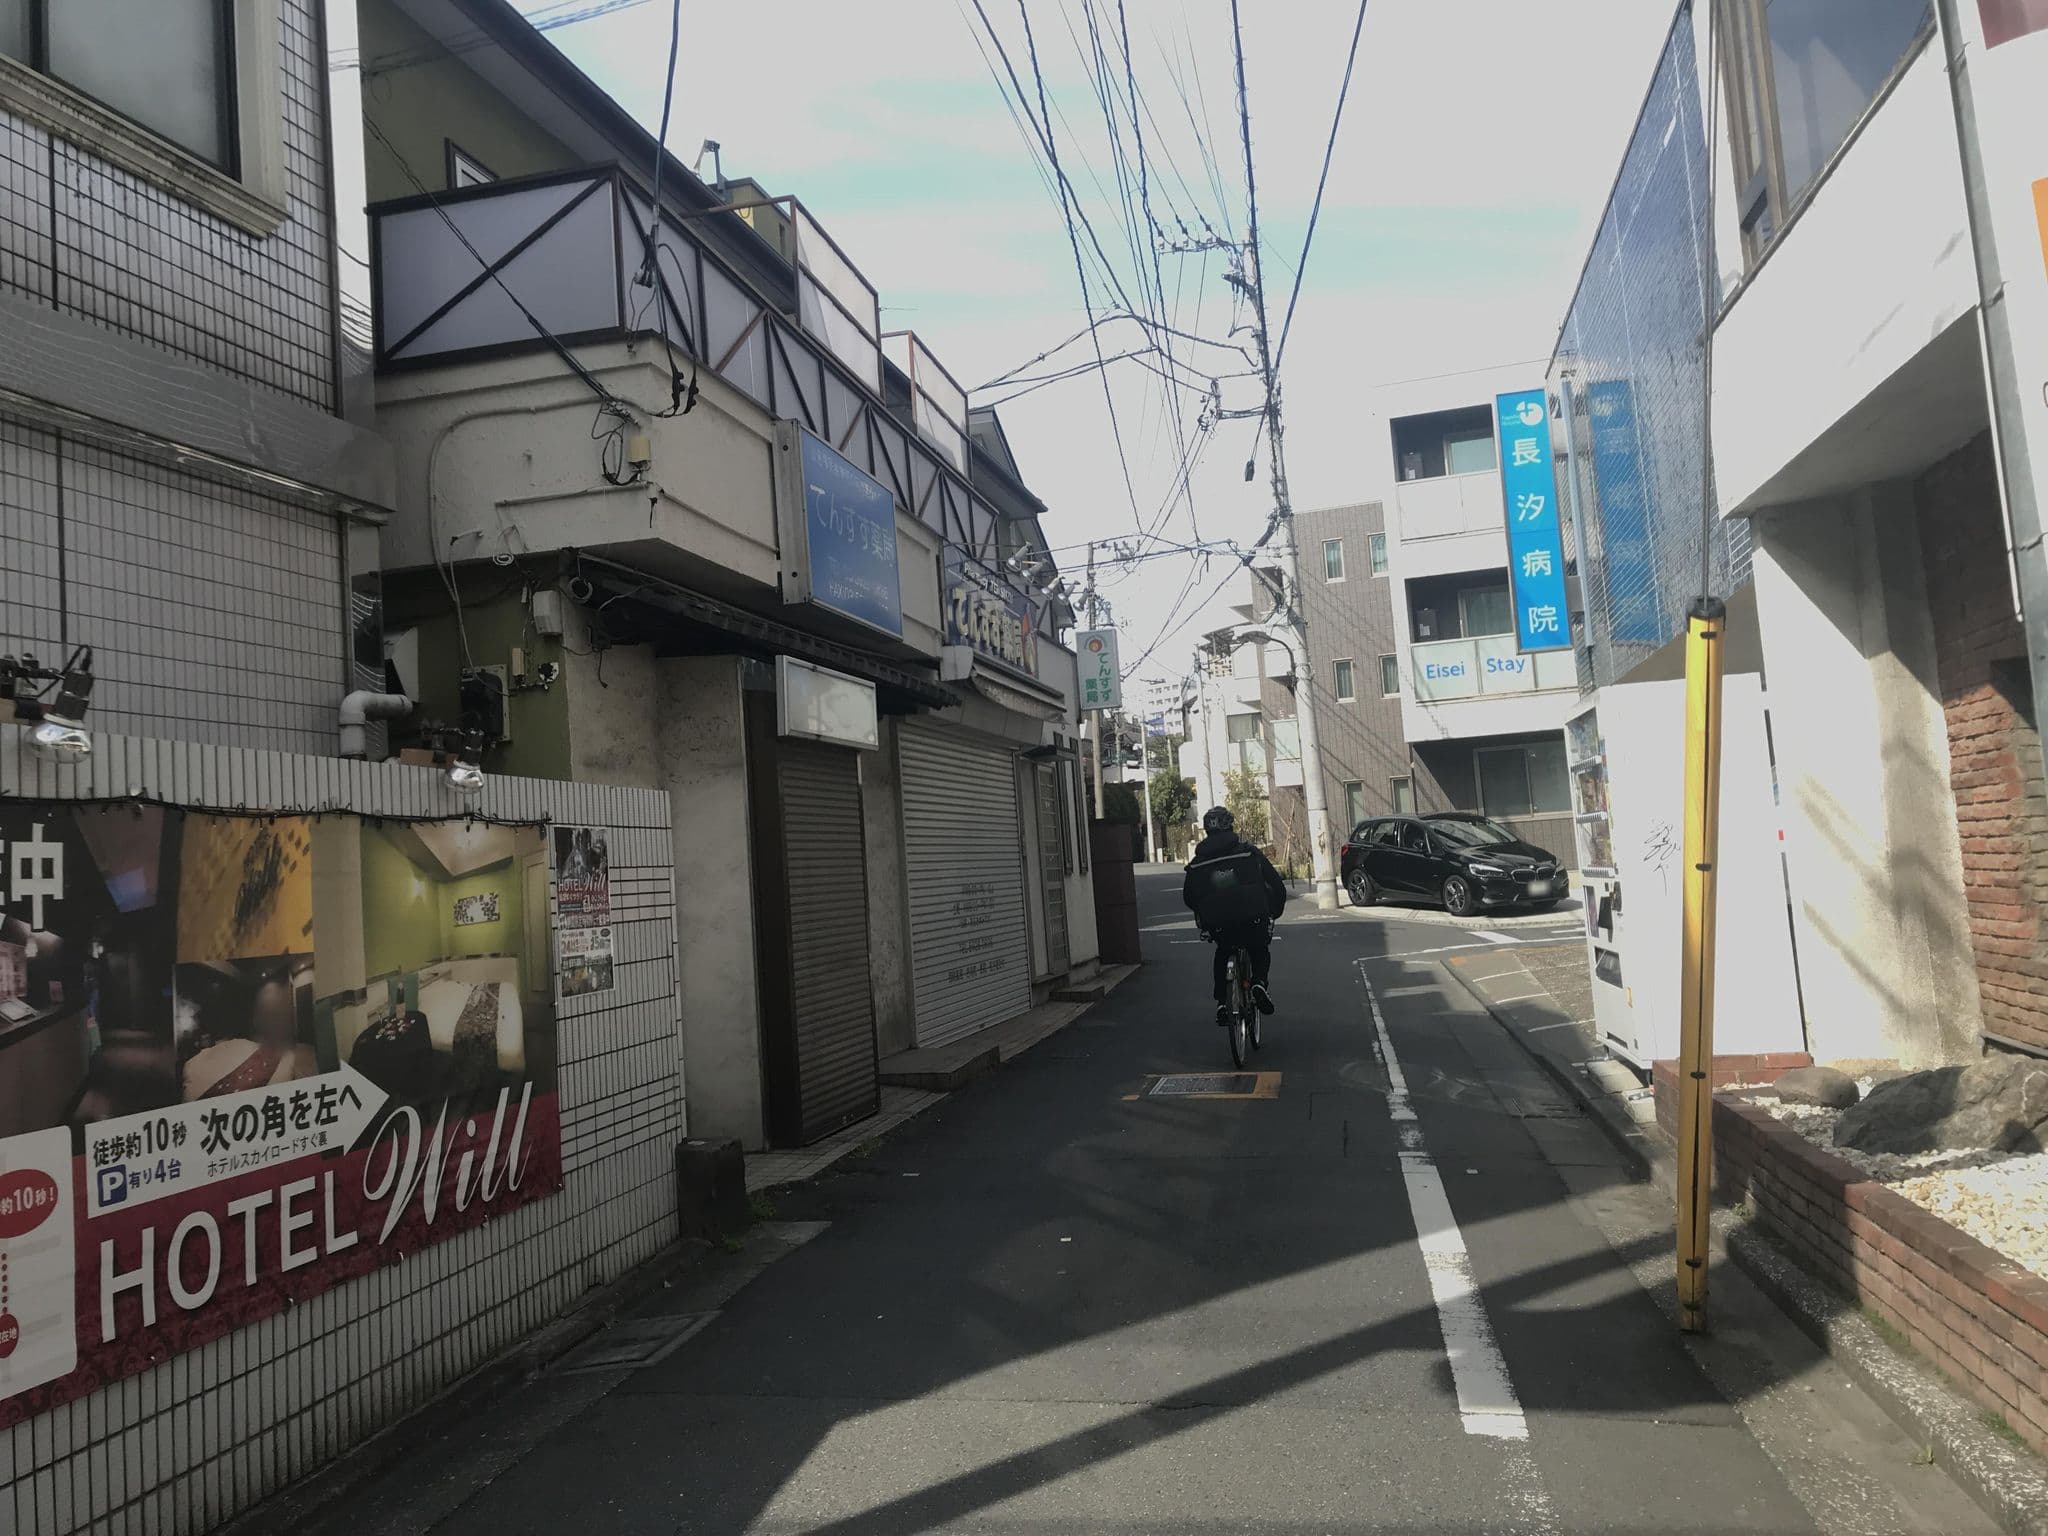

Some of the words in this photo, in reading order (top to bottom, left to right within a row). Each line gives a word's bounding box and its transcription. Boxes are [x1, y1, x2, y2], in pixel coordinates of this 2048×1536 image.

[1511, 437, 1559, 634] 長汐病院
[1426, 660, 1466, 680] Eisei
[1486, 651, 1526, 675] Stay
[558, 877, 583, 893] HOTEL
[93, 1117, 187, 1168] 徒歩約10秒
[200, 1083, 363, 1156] 次の角を左へ
[207, 1130, 328, 1178] ホテルスカイロードすぐ裏
[101, 1169, 358, 1344] HOTEL
[362, 1080, 534, 1246] Will
